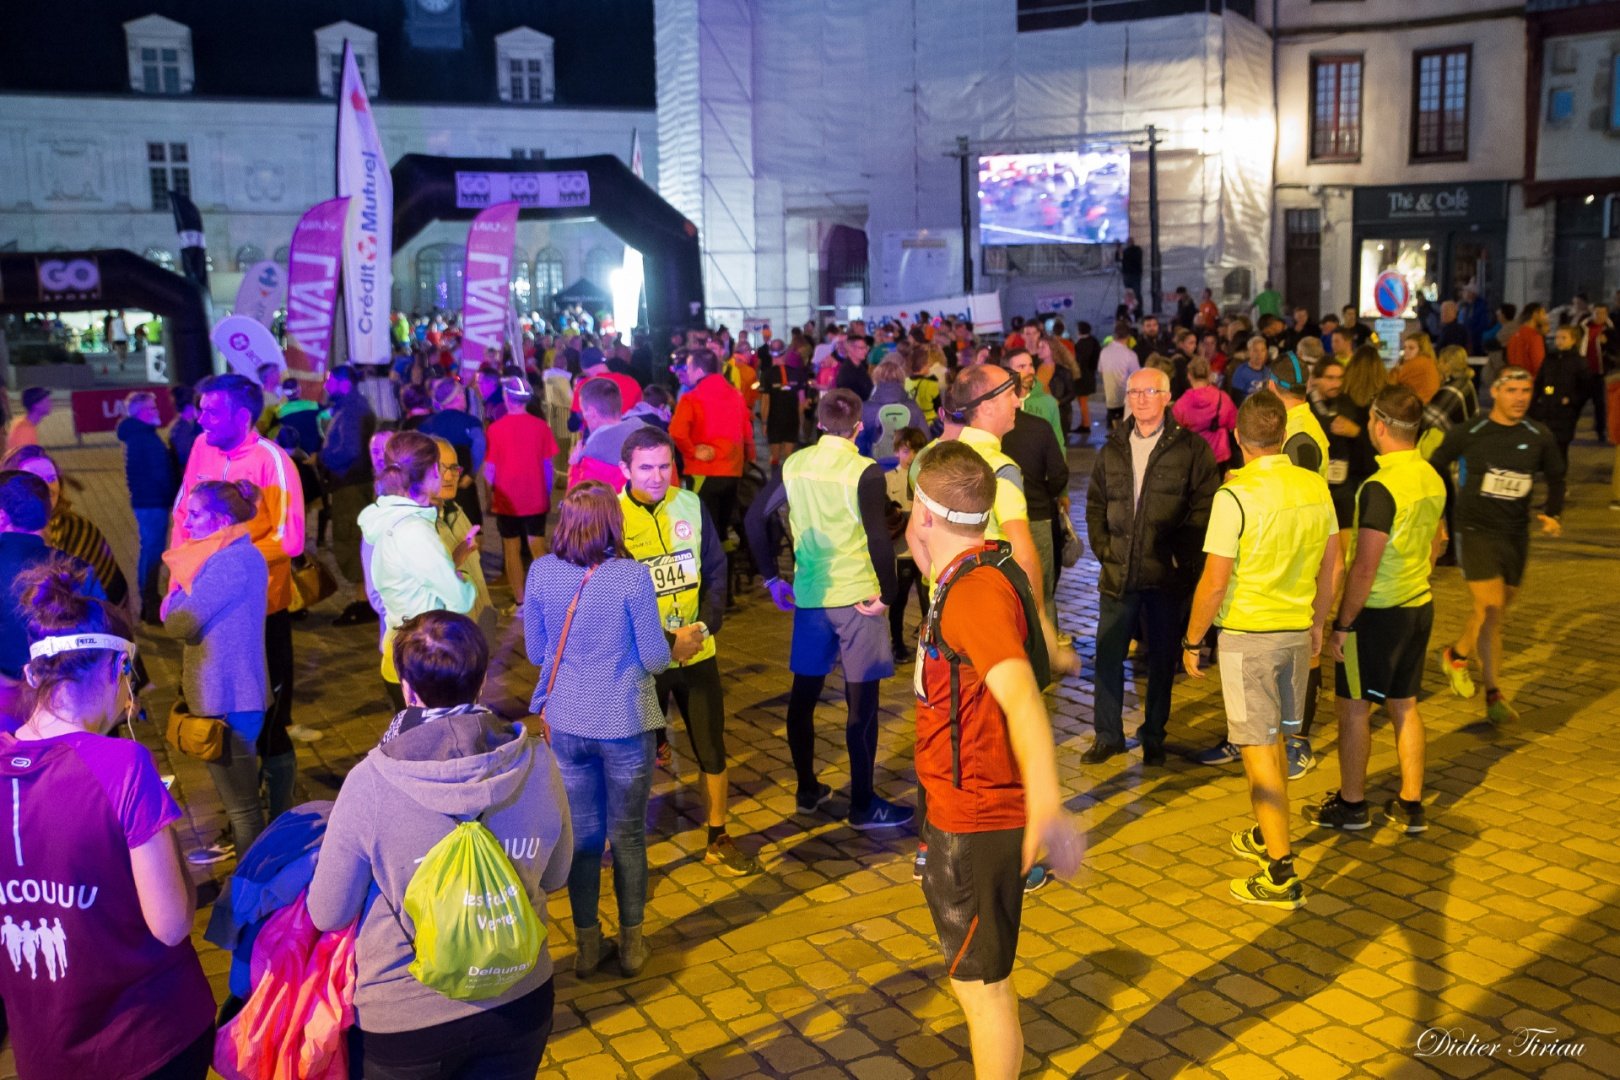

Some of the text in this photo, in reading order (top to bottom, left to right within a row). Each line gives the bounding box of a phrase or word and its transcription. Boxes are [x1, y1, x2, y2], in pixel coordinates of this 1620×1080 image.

[1415, 192, 1433, 211] &
[358, 151, 378, 335] Crédit Mutuel
[39, 259, 99, 291] GO
[654, 563, 686, 589] 944
